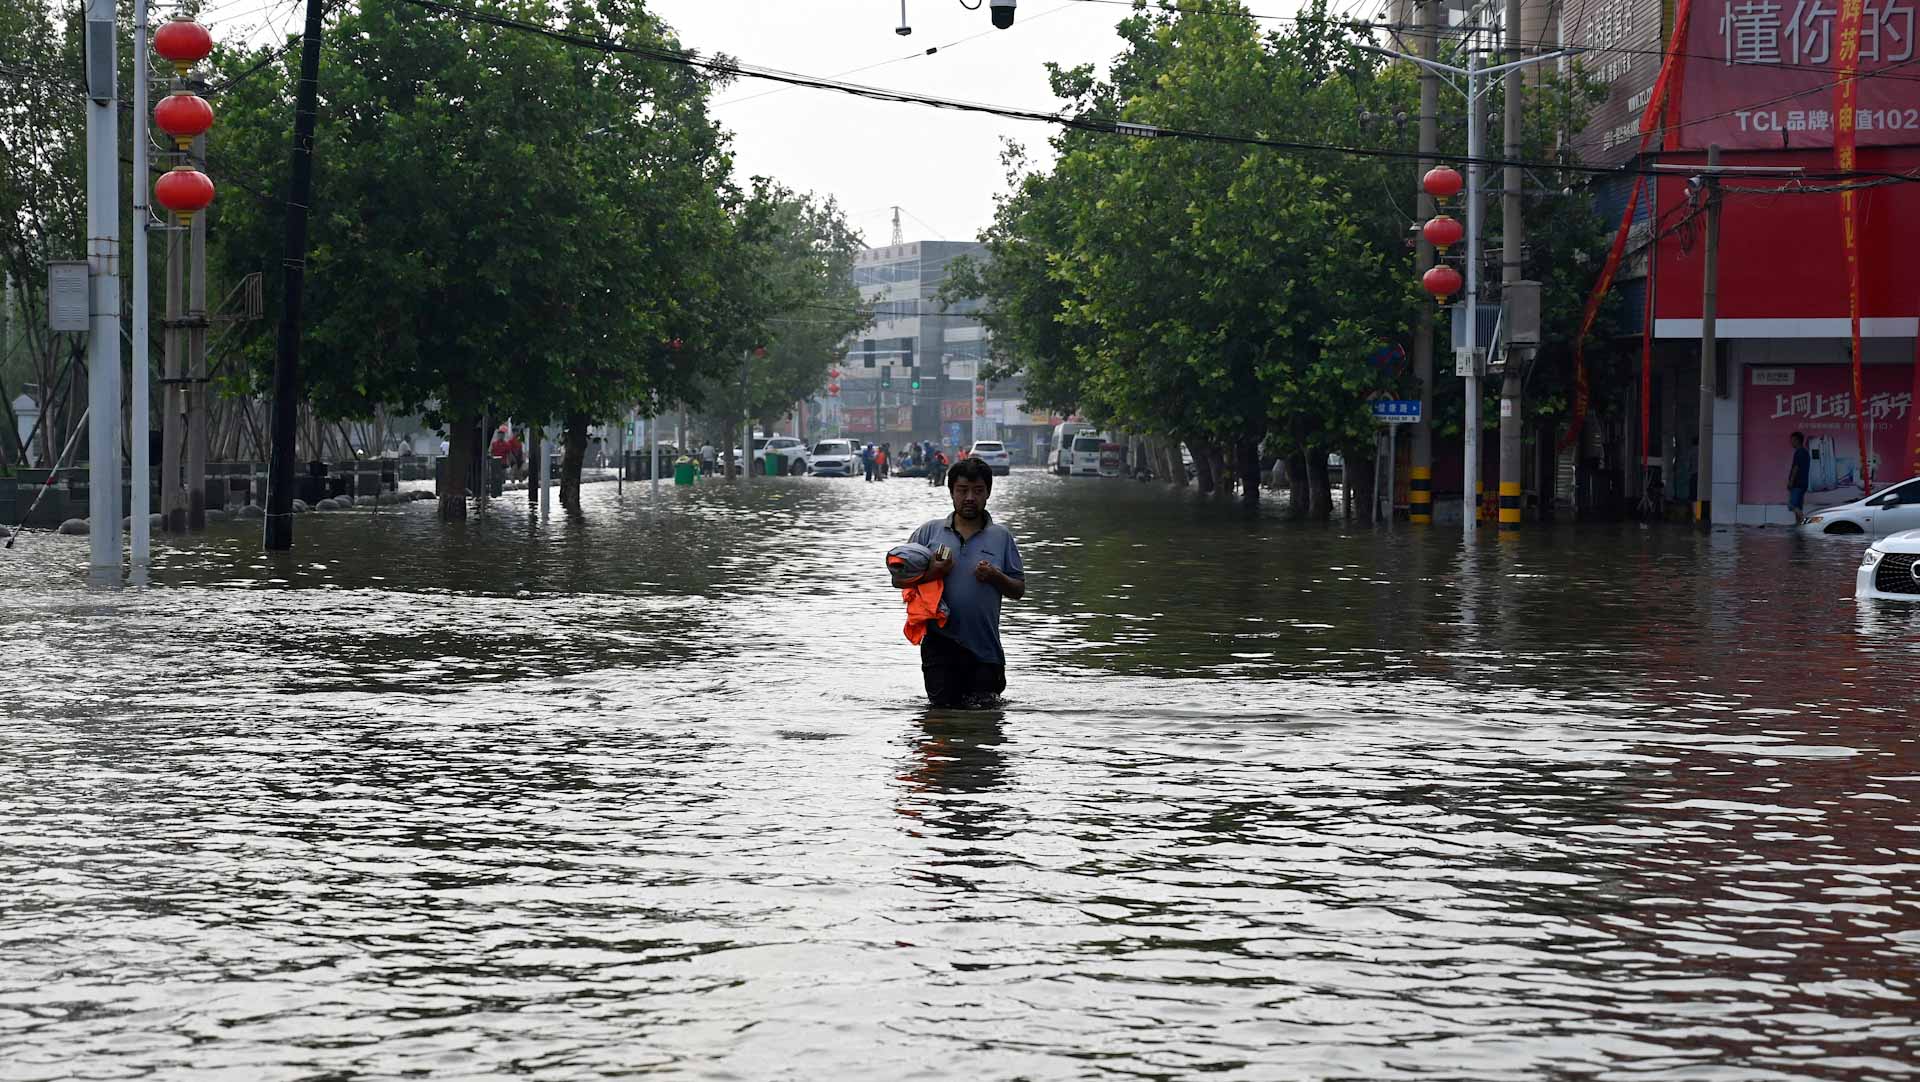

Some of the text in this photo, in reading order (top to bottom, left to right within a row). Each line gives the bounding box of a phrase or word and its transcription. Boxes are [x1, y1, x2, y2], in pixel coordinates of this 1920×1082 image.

[1719, 0, 1914, 66] 懂你的
[1736, 108, 1919, 131] TCL品牌值102
